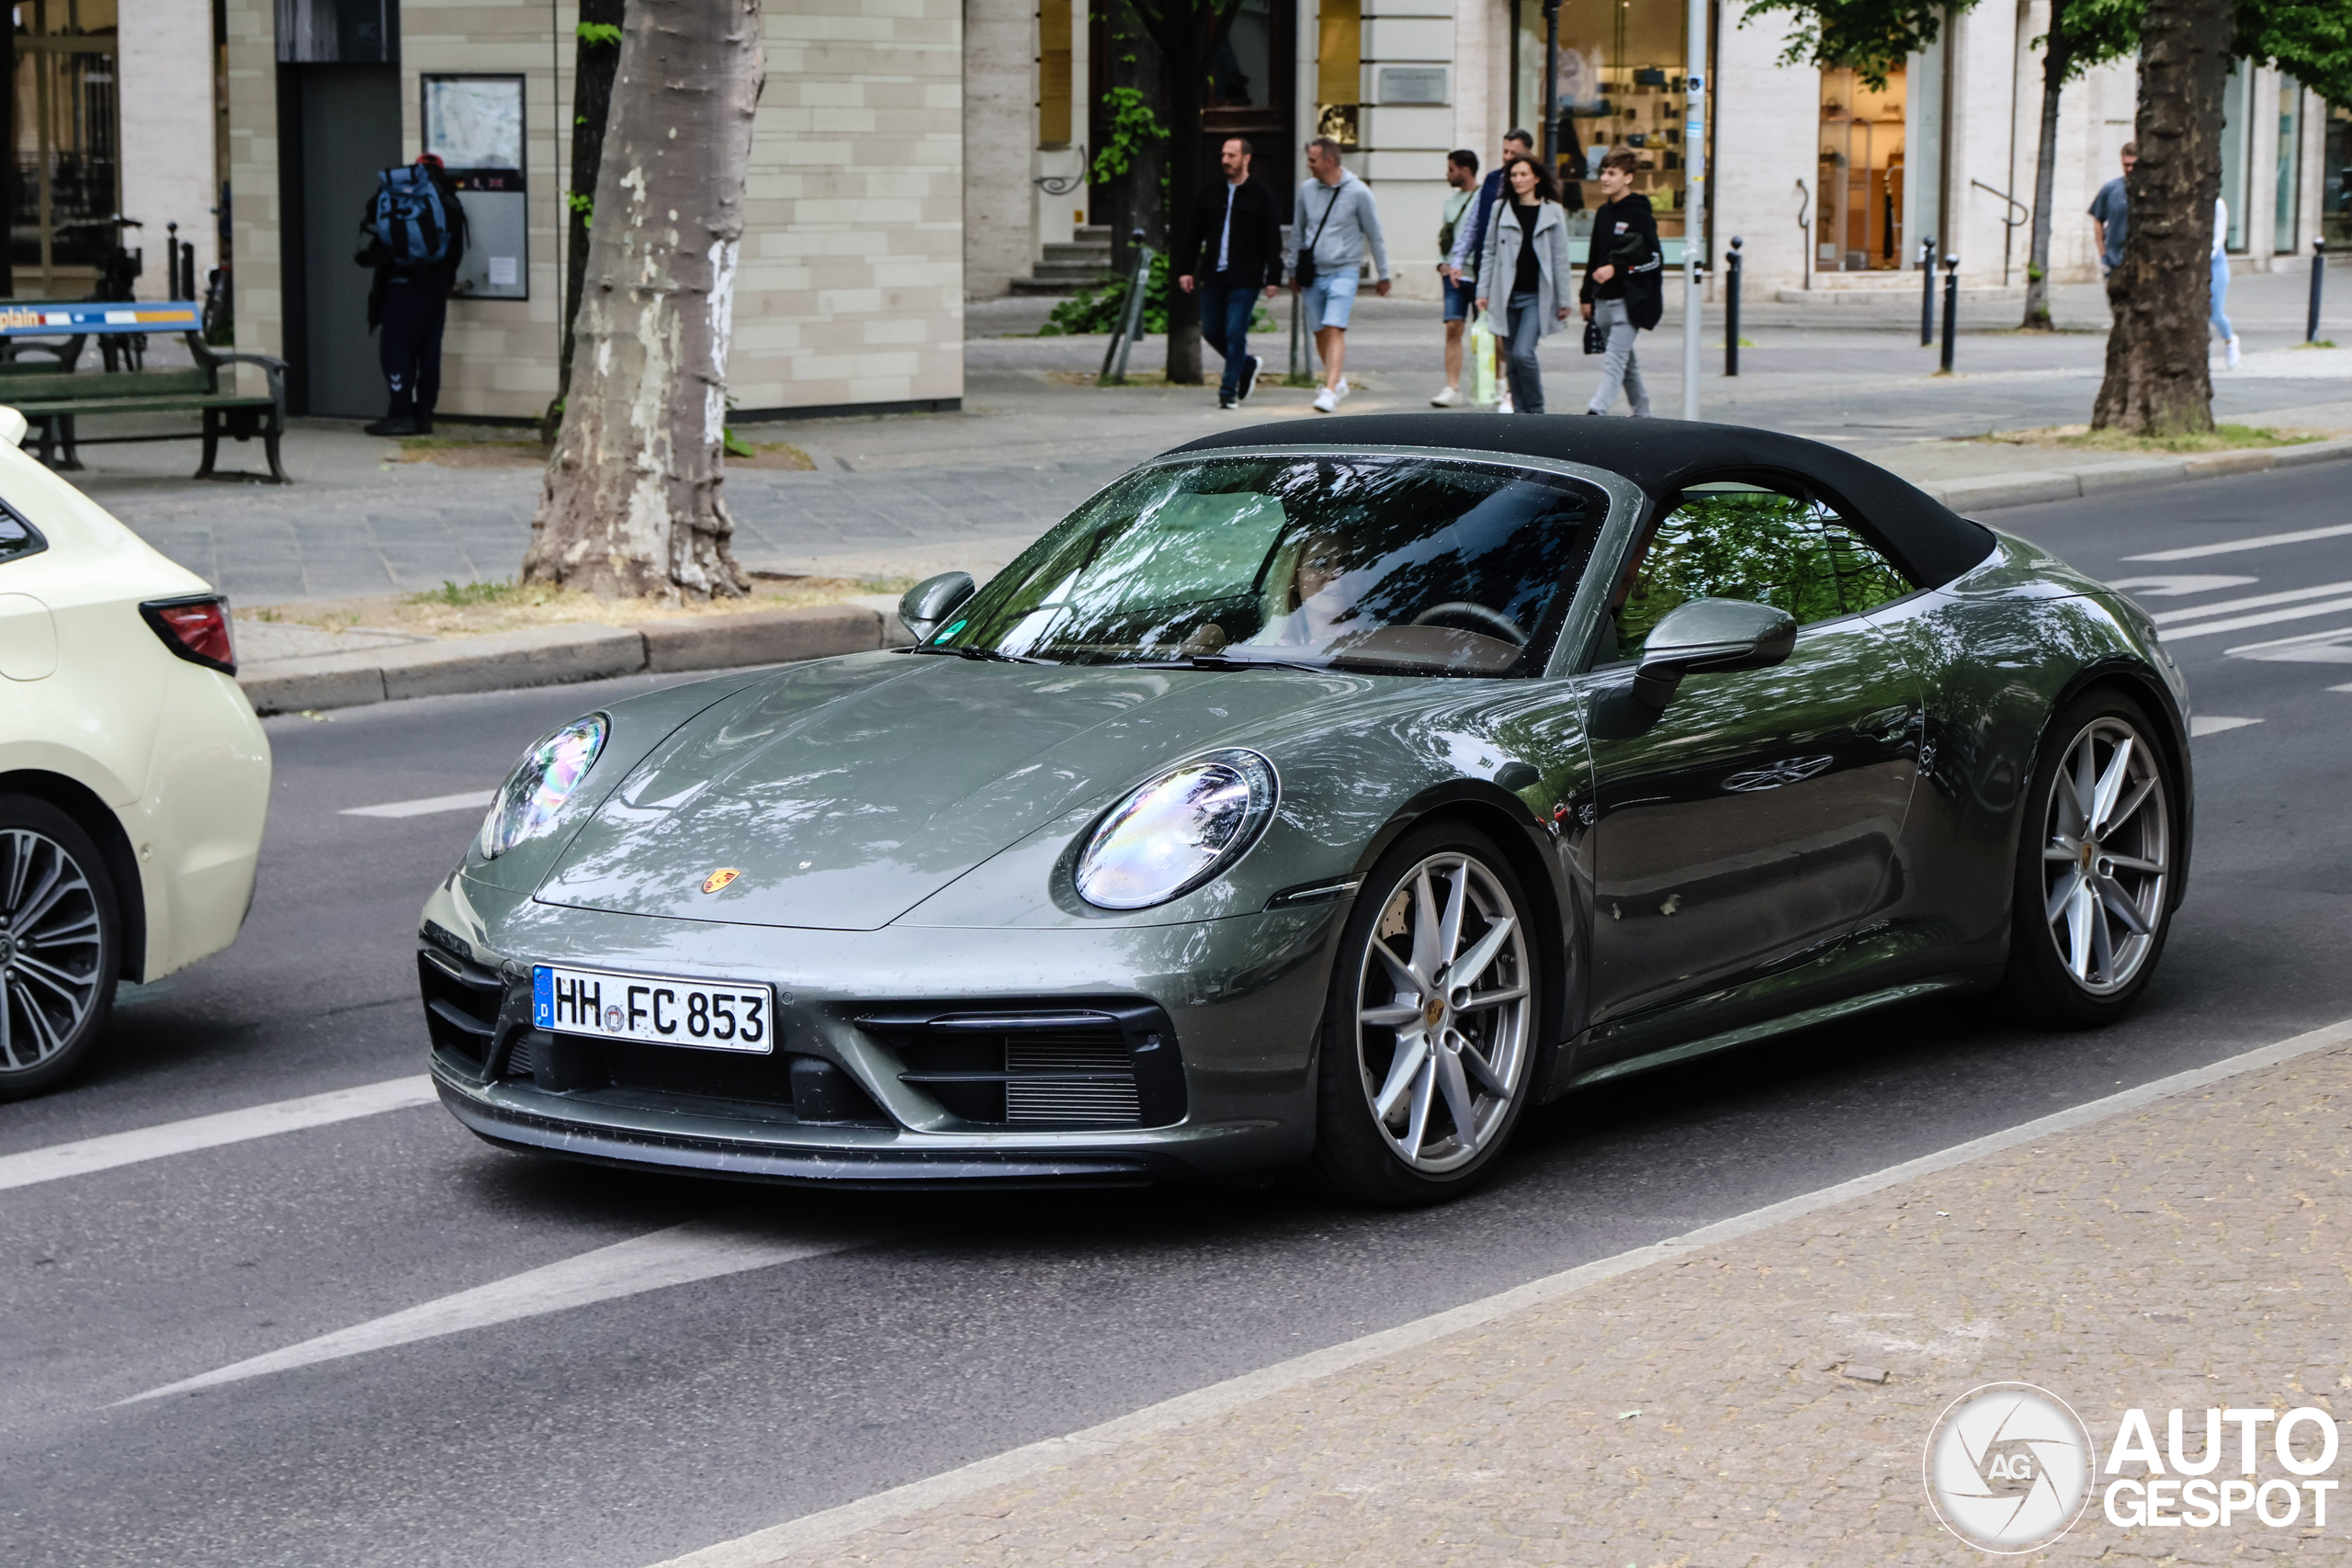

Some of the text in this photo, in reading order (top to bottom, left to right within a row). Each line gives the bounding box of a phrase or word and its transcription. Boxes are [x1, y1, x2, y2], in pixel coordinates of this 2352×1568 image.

[540, 1003, 549, 1018] D
[556, 976, 763, 1043] HH FC 853
